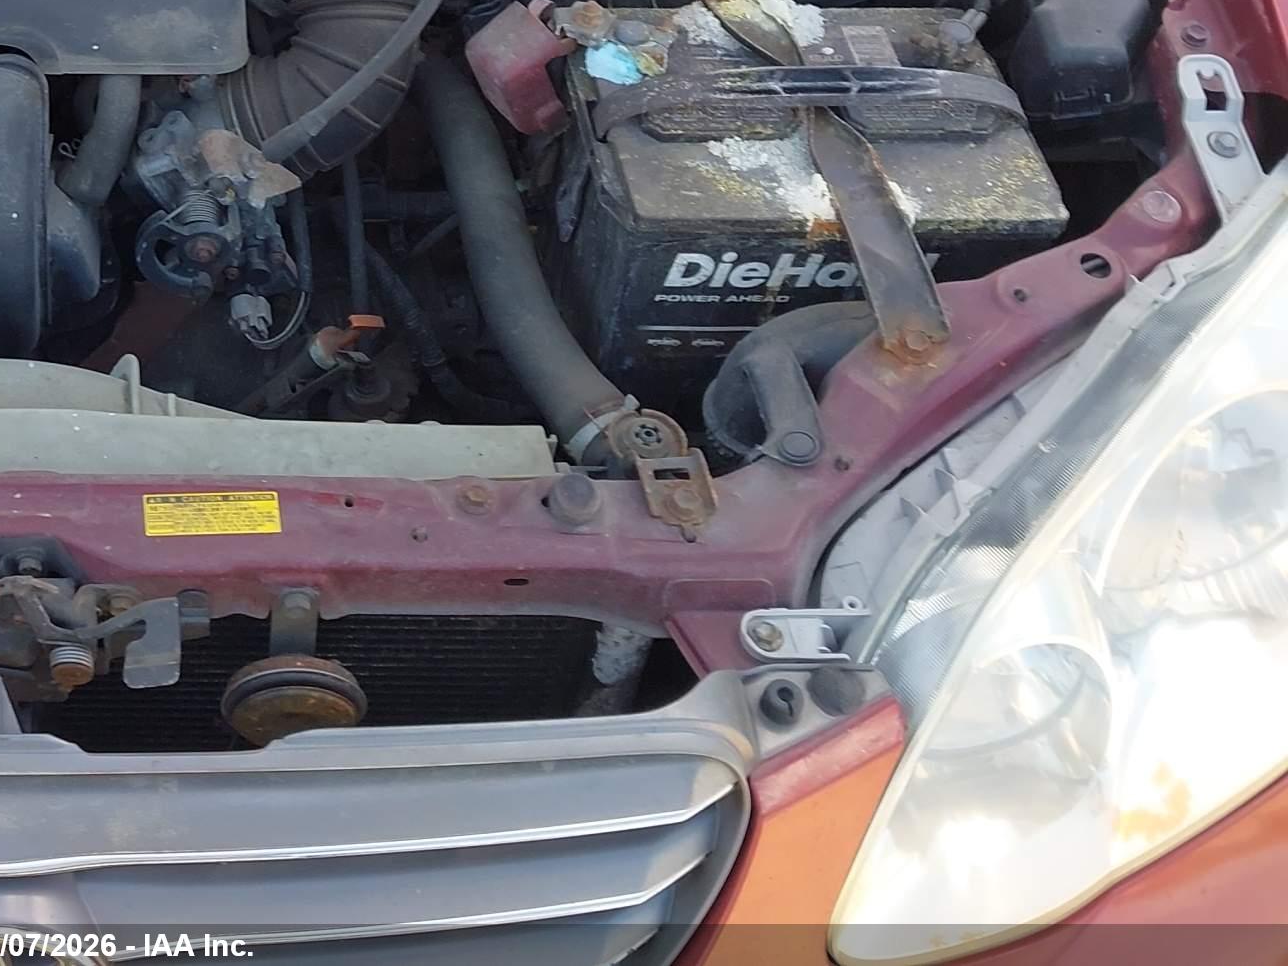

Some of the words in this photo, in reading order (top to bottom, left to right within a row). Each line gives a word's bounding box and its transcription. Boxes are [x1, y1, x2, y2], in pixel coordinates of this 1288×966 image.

[663, 252, 941, 289] DieHa
[653, 294, 721, 303] POWER
[724, 294, 791, 304] AHEAD
